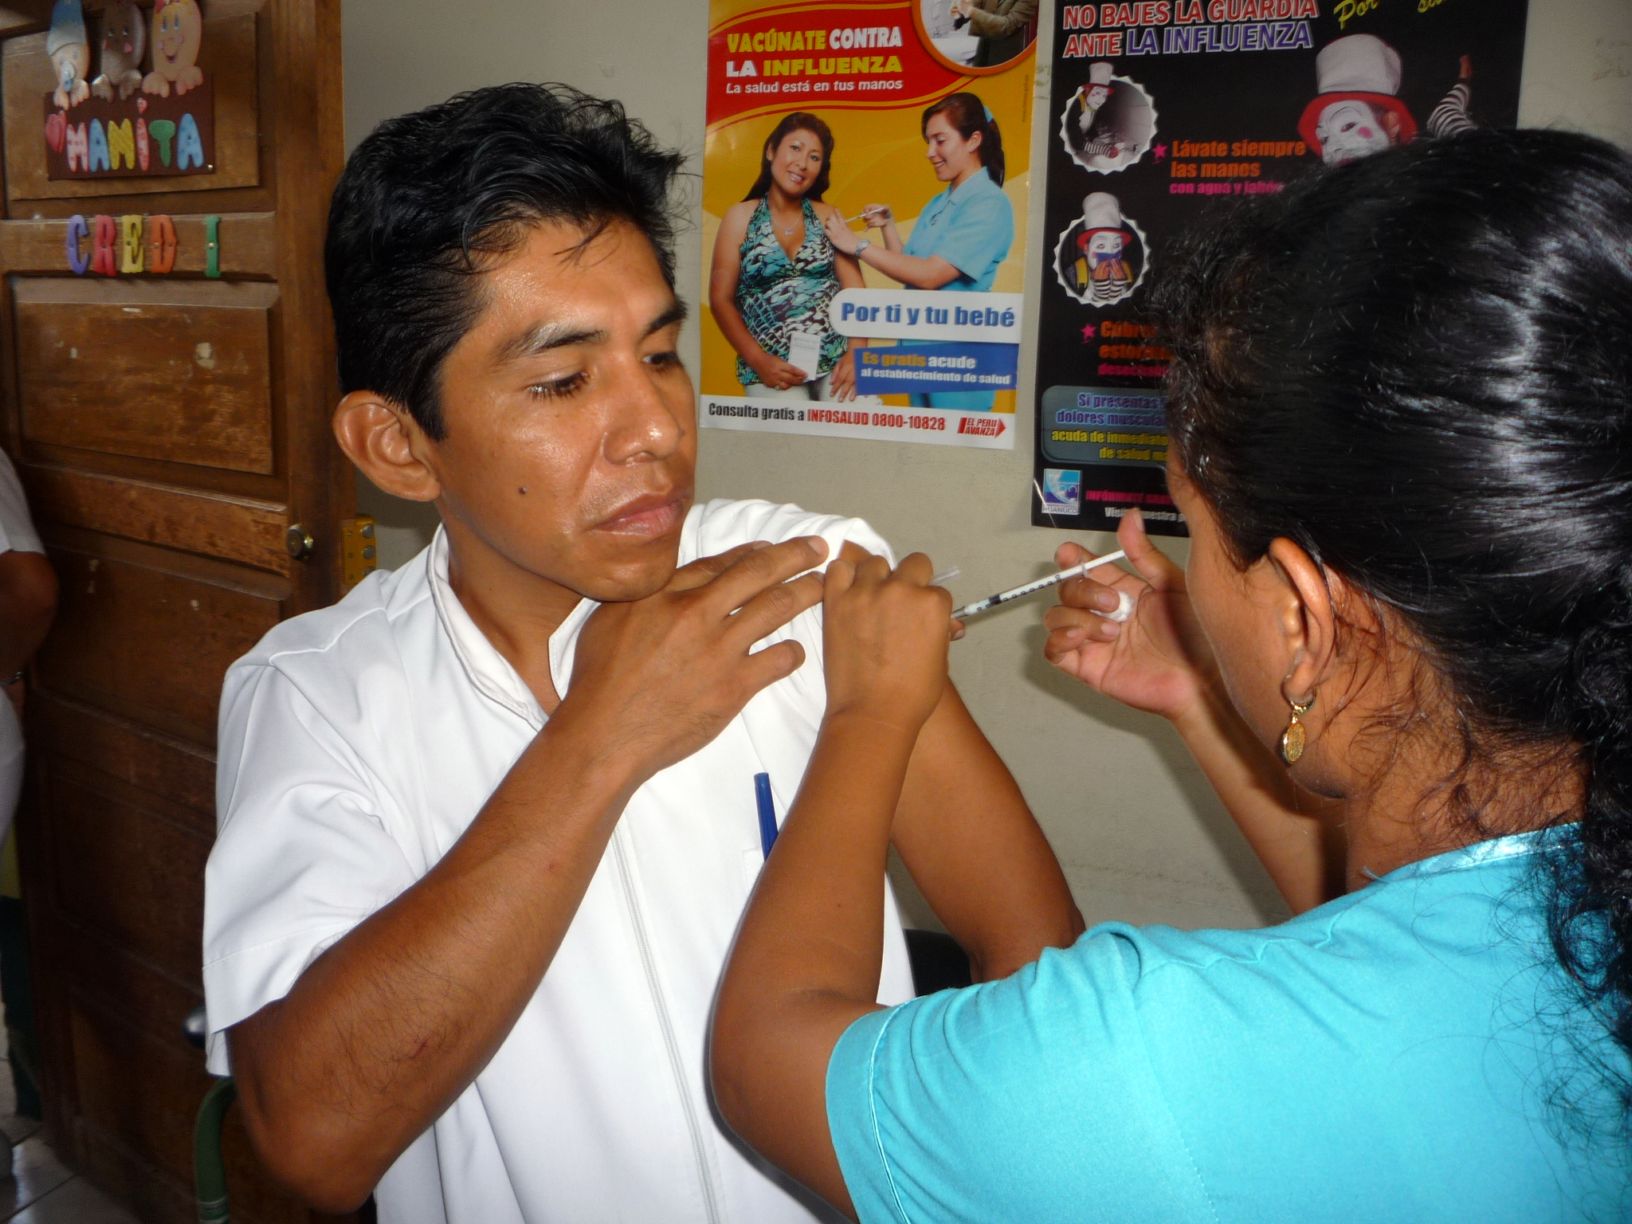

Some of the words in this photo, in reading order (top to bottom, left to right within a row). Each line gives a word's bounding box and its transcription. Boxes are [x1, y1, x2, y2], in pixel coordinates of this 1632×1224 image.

[1062, 4, 1097, 30] NO
[1100, 0, 1171, 27] BAJES
[1174, 0, 1205, 24] LA
[1206, 0, 1319, 23] GUARDIA
[727, 28, 827, 53] VACÚNATE
[829, 26, 902, 50] CONTRA
[1062, 32, 1122, 58] ANTE
[1125, 28, 1159, 56] LA
[1162, 21, 1314, 54] INFLUENZA
[726, 60, 757, 77] LA
[763, 55, 902, 77] INFLUENZA
[726, 82, 741, 94] La
[745, 81, 779, 94] salud
[782, 80, 810, 93] está
[814, 82, 830, 92] en
[833, 81, 854, 92] tus
[858, 79, 903, 91] manos
[1171, 139, 1228, 158] Lávate
[1231, 139, 1306, 158] siempre
[1170, 161, 1197, 177] las
[1200, 162, 1261, 178] manos
[1197, 182, 1232, 195] agua
[66, 214, 177, 276] CRED
[841, 302, 880, 323] Por
[885, 304, 901, 324] ti
[906, 308, 920, 326] y
[924, 306, 948, 326] tu
[954, 306, 1015, 328] bebé
[862, 352, 879, 365] Es
[881, 353, 927, 367] gratis
[928, 355, 976, 369] acude
[861, 368, 871, 378] al
[873, 368, 961, 382] establecimiento
[962, 373, 977, 383] de
[978, 374, 1011, 385] salud
[1078, 392, 1092, 408] Si
[708, 402, 759, 419] Consulta
[761, 406, 795, 421] gratis
[797, 409, 805, 421] a
[807, 408, 869, 426] INFOSALUD
[872, 413, 946, 431] 0800-10828
[1056, 409, 1104, 425] dolores
[1052, 429, 1088, 442] acuda
[1090, 430, 1104, 443] de
[1099, 446, 1116, 460] de
